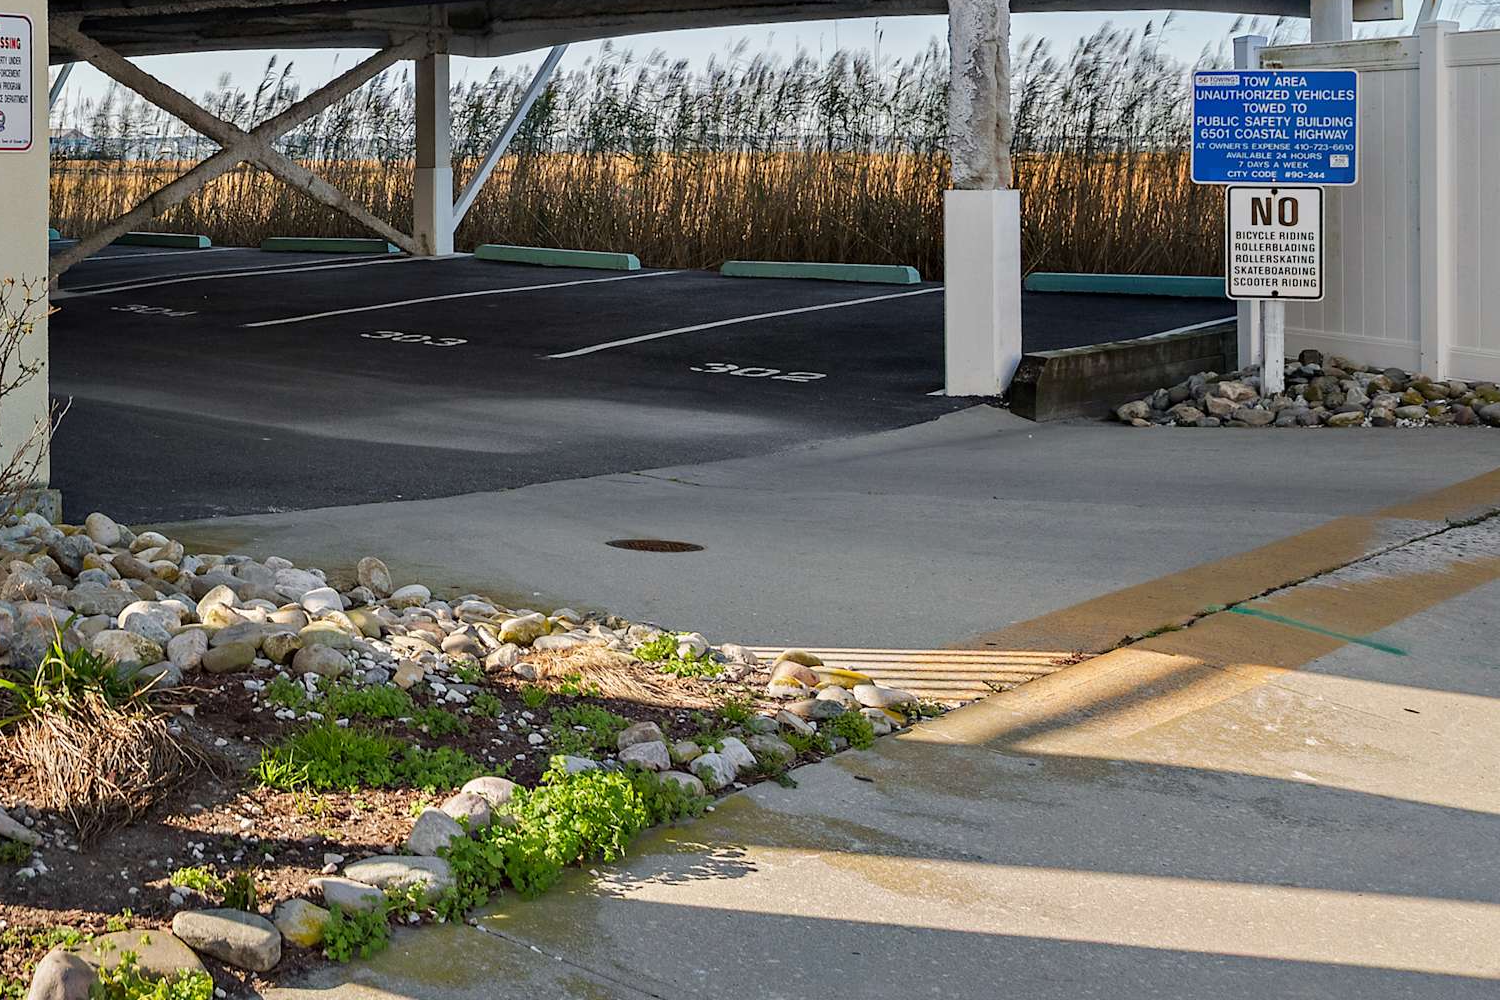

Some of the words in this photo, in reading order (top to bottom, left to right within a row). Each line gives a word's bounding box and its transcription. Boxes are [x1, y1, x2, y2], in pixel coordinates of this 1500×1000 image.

[8, 56, 21, 65] UNDER
[3, 82, 21, 90] PROGRAM
[1243, 77, 1269, 86] TOW
[1275, 77, 1307, 87] AREA
[4, 95, 28, 103] DEPARTMENT
[1196, 90, 1289, 100] UNAUTHORIZED
[1295, 90, 1354, 100] VEHICLES
[1243, 103, 1286, 113] TOWED
[1291, 103, 1307, 113] TO
[1197, 117, 1239, 126] PUBLIC
[1245, 117, 1291, 127] SAFETY
[1296, 117, 1353, 127] BUILDING
[1200, 129, 1229, 138] 6501
[1235, 129, 1288, 139] COASTAL
[1294, 130, 1348, 139] HIGHWAY
[1294, 143, 1354, 151] 410-723-6610
[1251, 197, 1299, 227] NO
[1235, 231, 1275, 240] BICYCLE
[1279, 232, 1315, 241] RIDING
[1235, 243, 1315, 252] ROLLERBLADING
[1235, 255, 1315, 264] ROLLERSKATING
[1234, 266, 1316, 276] SKATEBOARDING
[1233, 277, 1278, 287] SCOOTER
[1282, 279, 1317, 288] RIDING
[360, 330, 468, 347] 303
[689, 362, 827, 383] 302
